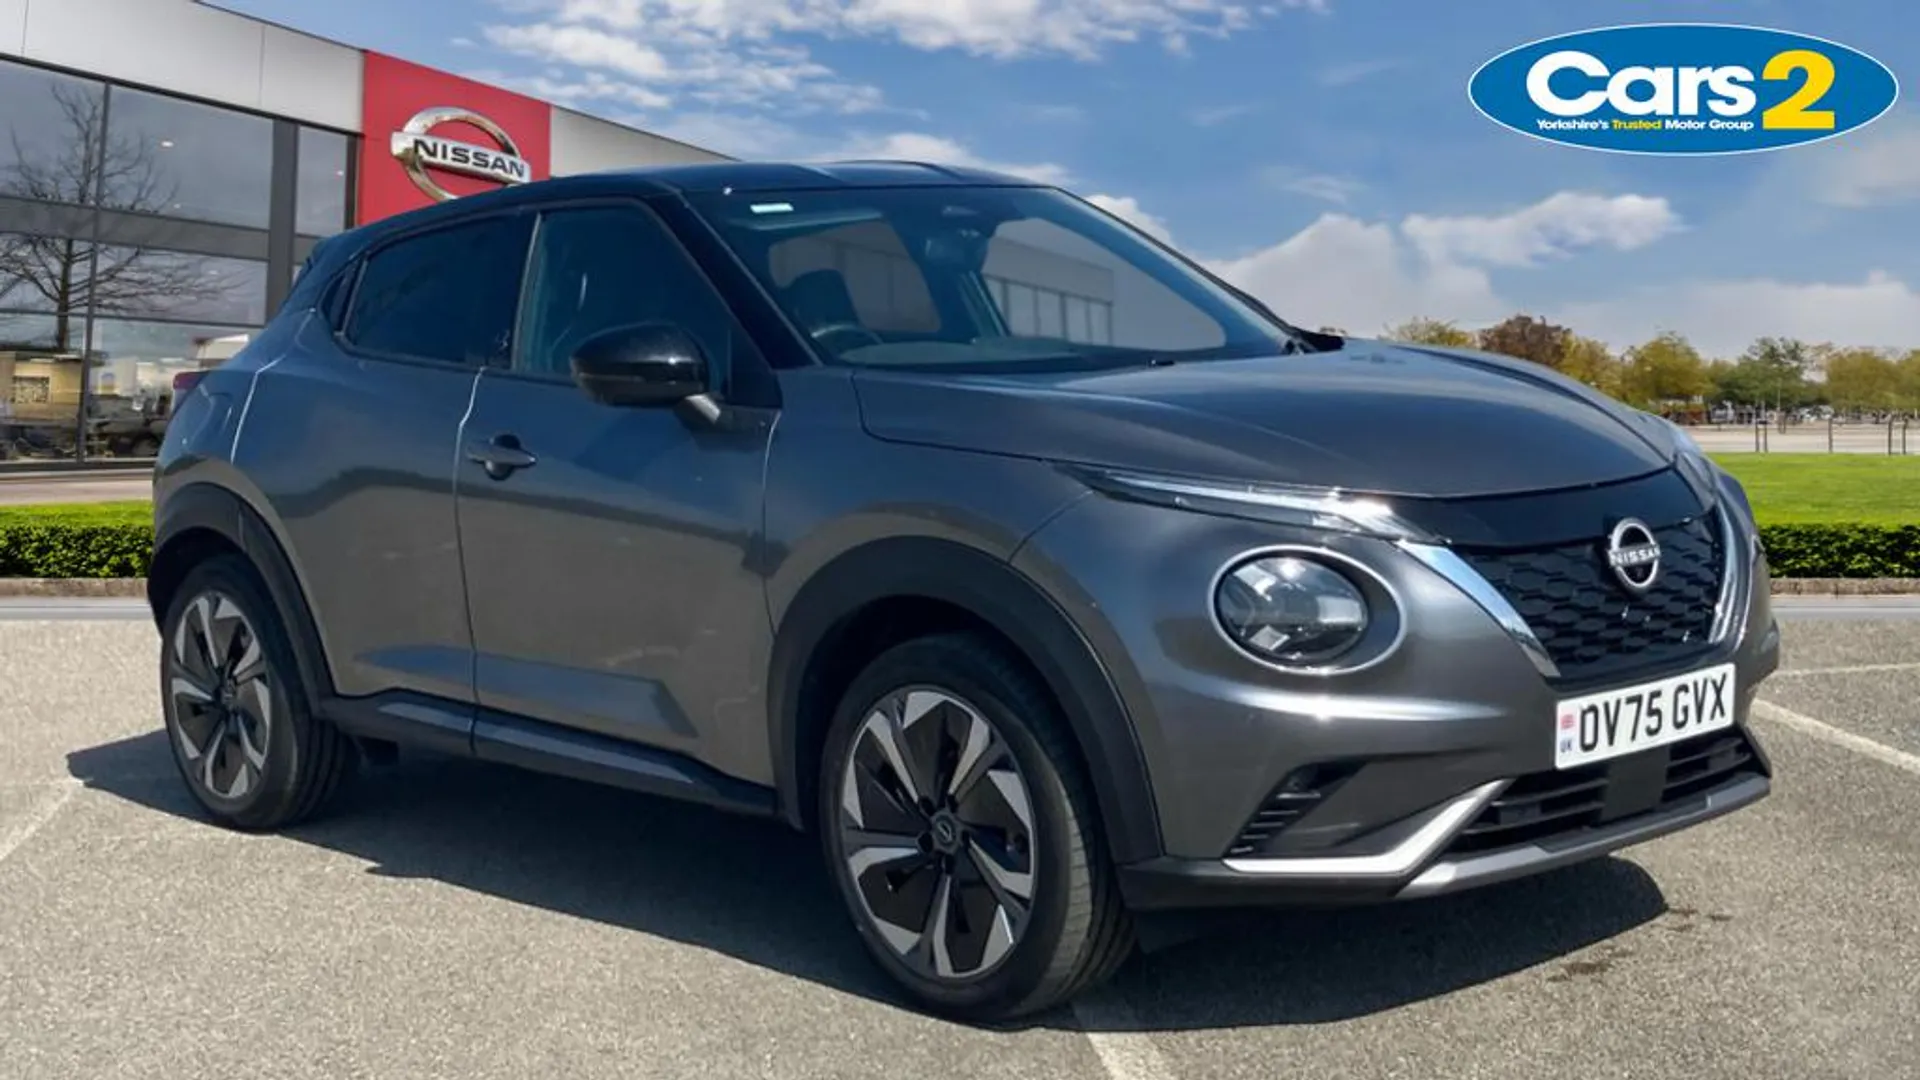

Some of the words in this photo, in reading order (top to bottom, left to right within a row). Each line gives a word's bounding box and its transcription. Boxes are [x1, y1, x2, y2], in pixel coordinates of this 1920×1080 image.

[413, 139, 525, 178] NISSAN
[1609, 547, 1661, 567] NISSAN
[1580, 690, 1663, 753] OV75
[1671, 672, 1728, 731] GVX
